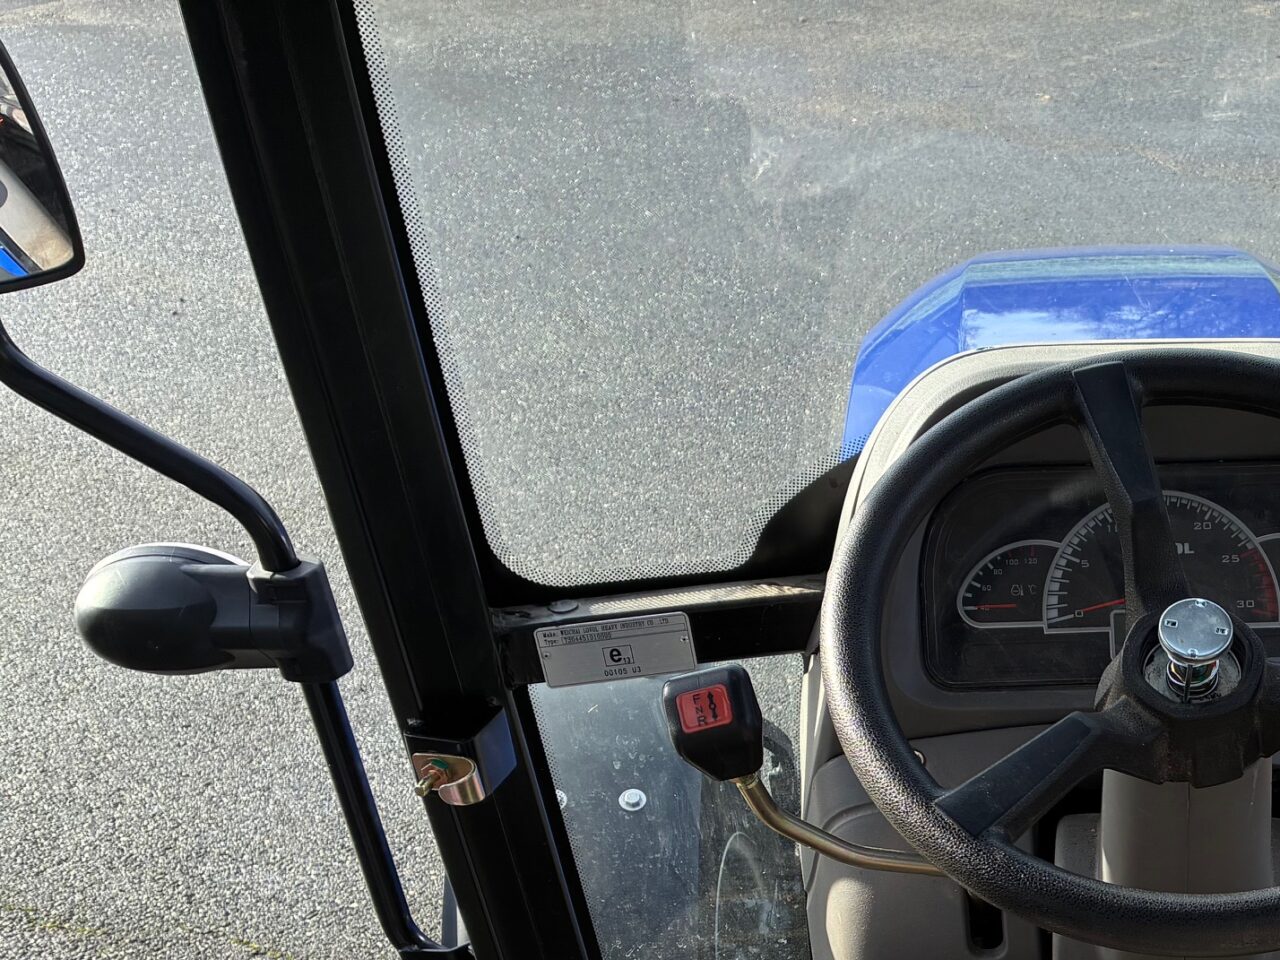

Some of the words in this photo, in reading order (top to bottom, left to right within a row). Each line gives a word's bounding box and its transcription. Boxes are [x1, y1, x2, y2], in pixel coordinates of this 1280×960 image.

[1193, 522, 1212, 530] 20
[1221, 554, 1240, 563] 25
[1081, 559, 1090, 568] 5
[981, 584, 992, 592] 60
[1236, 600, 1255, 608] 30
[1075, 609, 1084, 617] 0
[692, 693, 702, 704] F
[696, 706, 704, 715] N
[697, 716, 707, 727] R
